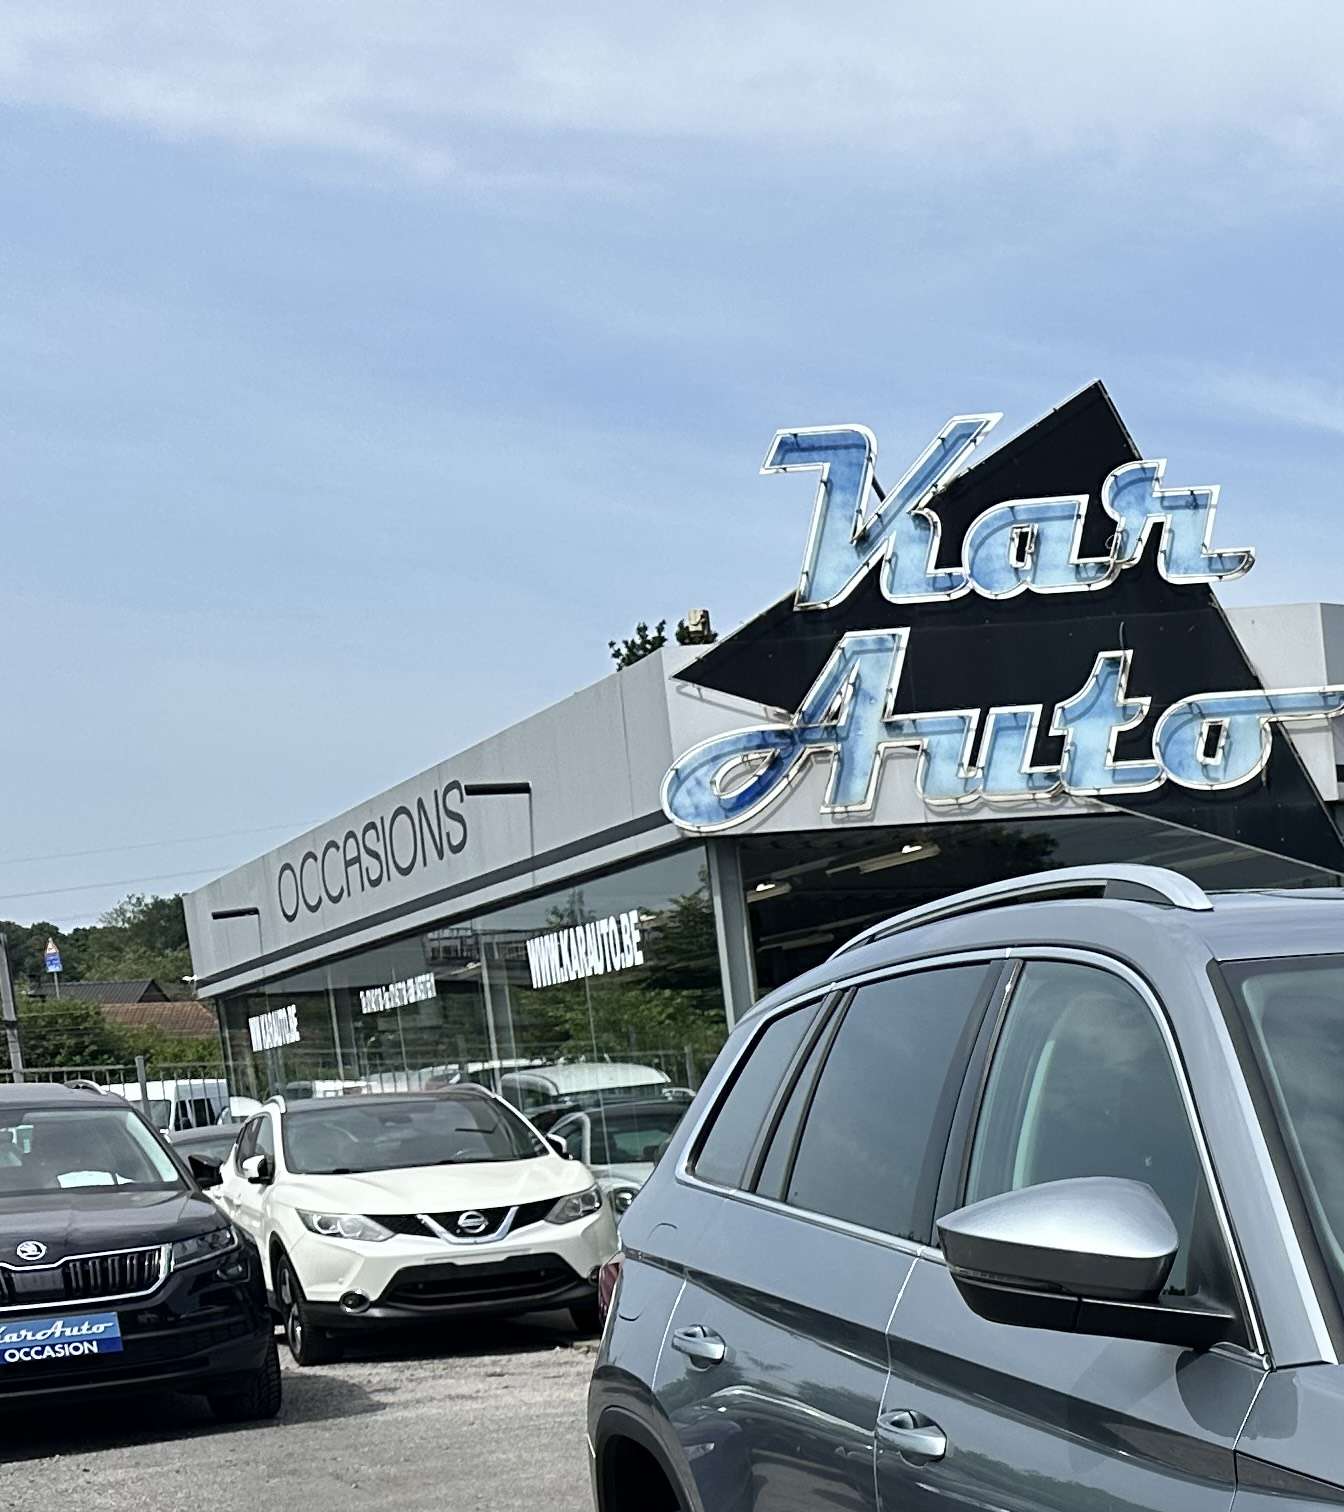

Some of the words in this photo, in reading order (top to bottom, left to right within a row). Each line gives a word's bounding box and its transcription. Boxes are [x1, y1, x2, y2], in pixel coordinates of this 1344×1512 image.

[760, 413, 1255, 610] Kar
[278, 780, 467, 921] OCCASIONS
[4, 1340, 98, 1362] OCCASION
